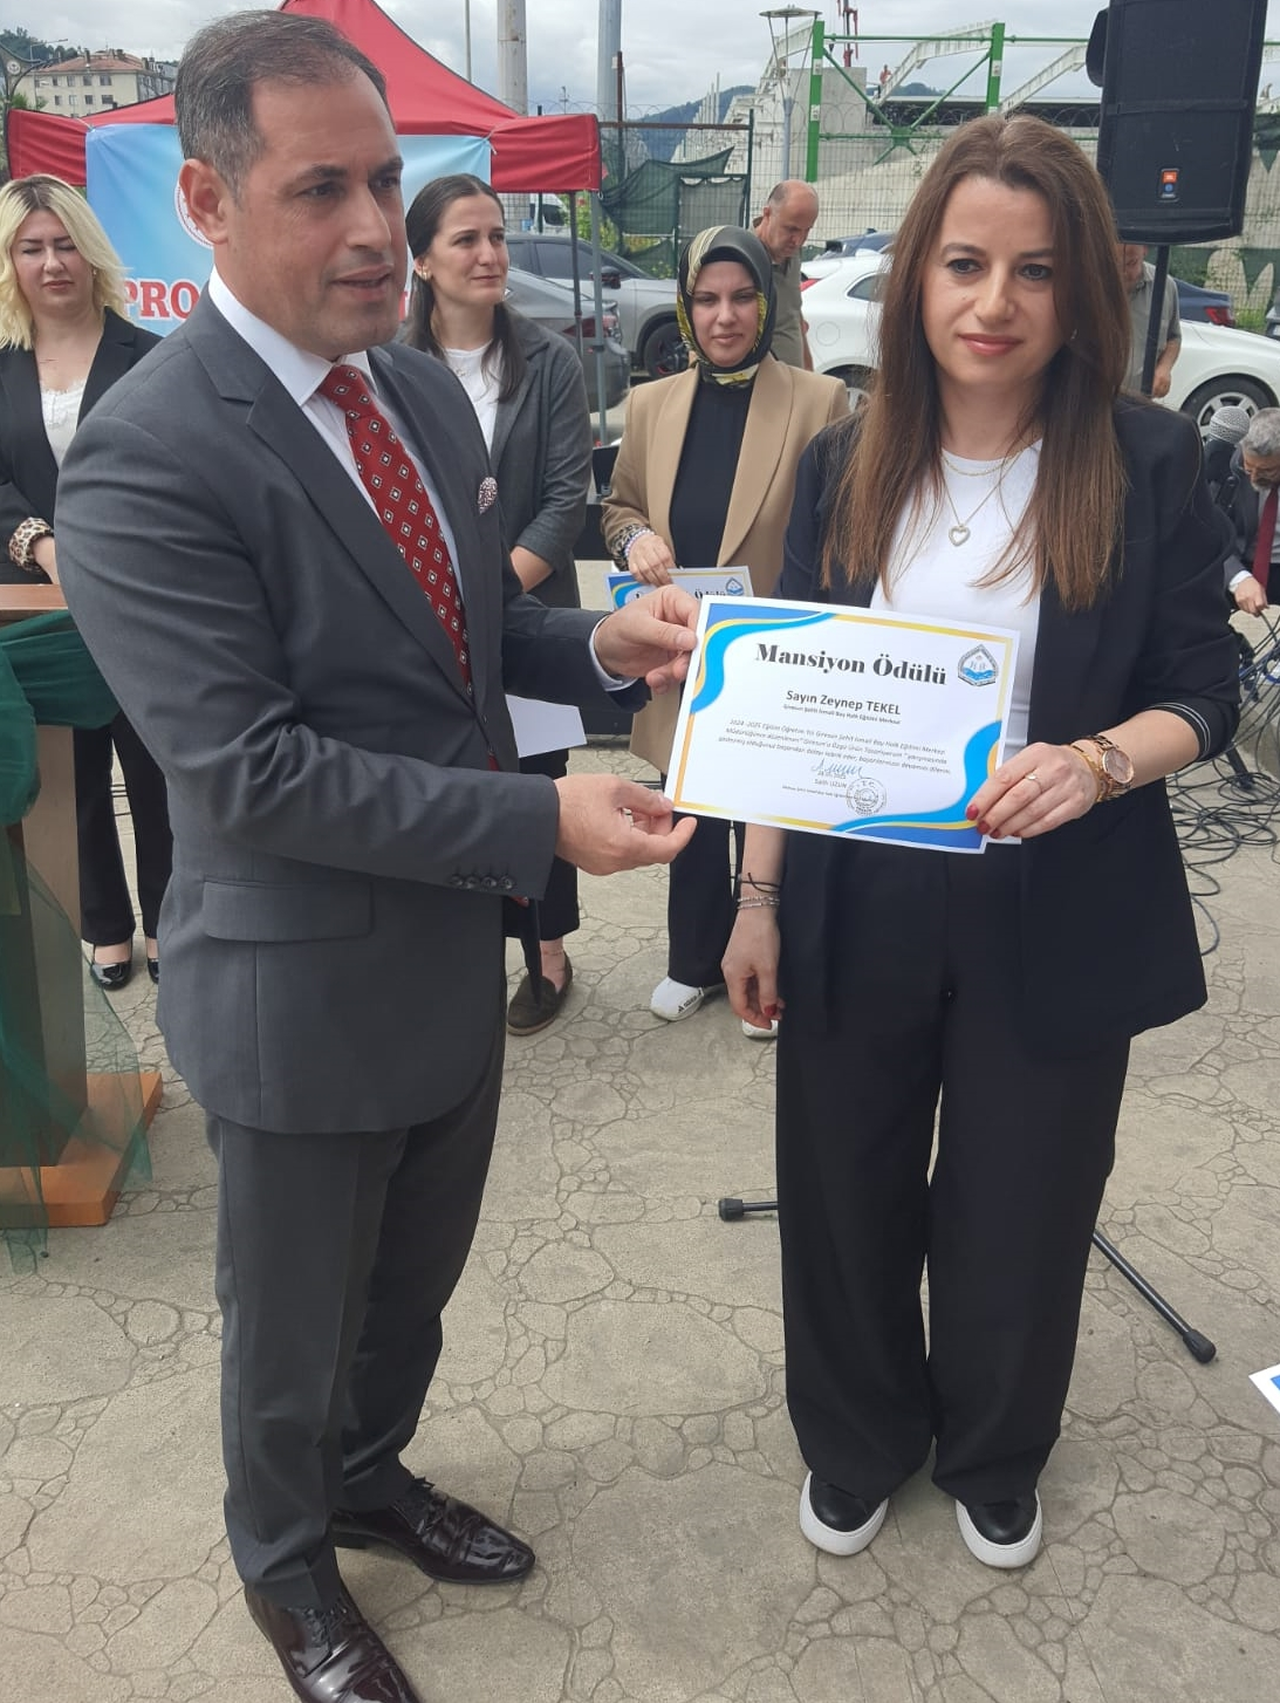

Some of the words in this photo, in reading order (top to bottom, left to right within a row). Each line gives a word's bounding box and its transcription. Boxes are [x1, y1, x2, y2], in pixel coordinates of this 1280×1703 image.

[756, 643, 865, 674] Mansiyon
[872, 653, 947, 685] Ödülü
[785, 690, 818, 705] Sayın
[820, 694, 863, 712] Zeynep
[866, 700, 901, 716] TEKEL
